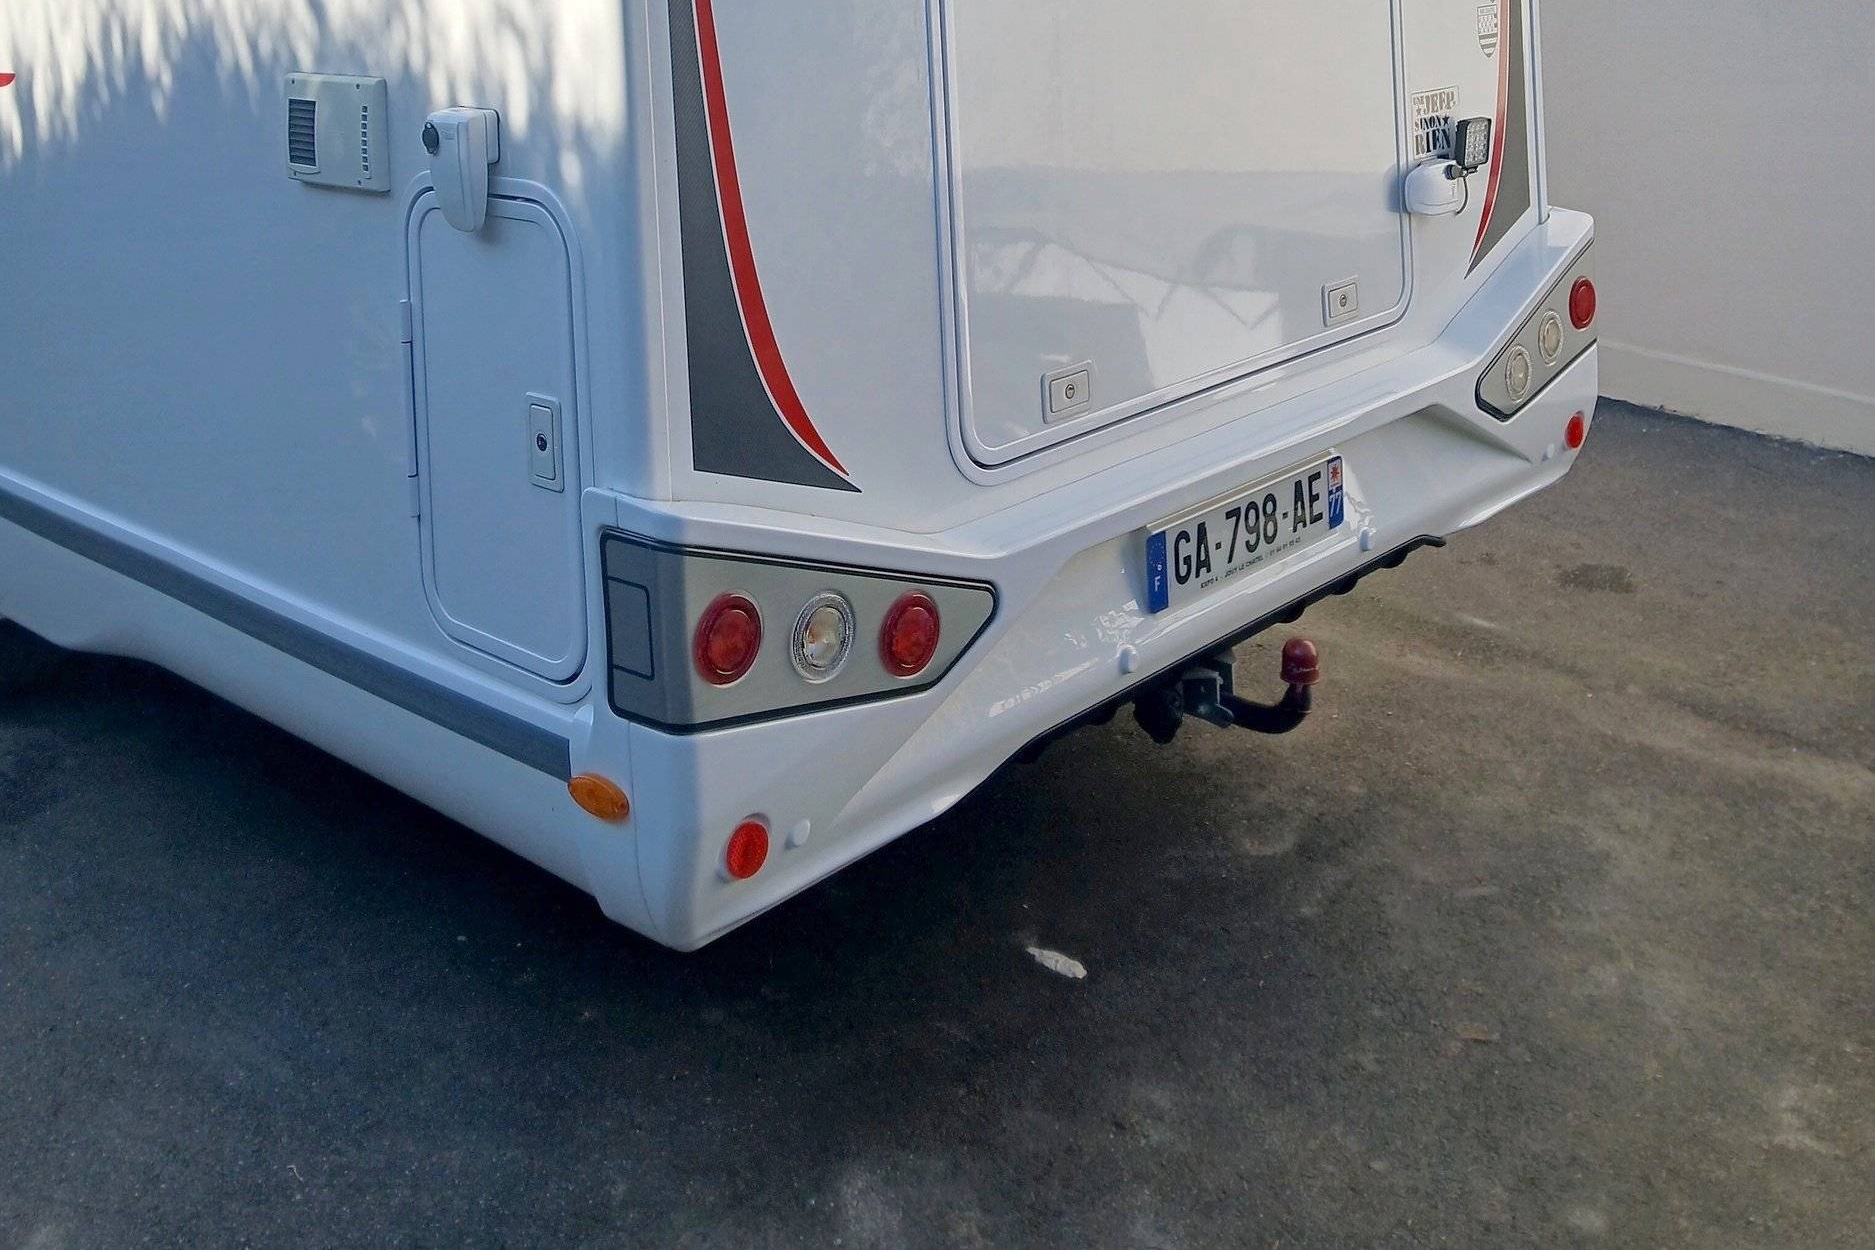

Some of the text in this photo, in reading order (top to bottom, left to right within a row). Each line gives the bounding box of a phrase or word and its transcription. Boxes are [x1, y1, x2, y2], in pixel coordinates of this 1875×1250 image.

[1415, 128, 1451, 156] RIEN
[1329, 491, 1342, 518] 77
[1174, 470, 1324, 585] GA-798-AE
[1154, 575, 1161, 592] F
